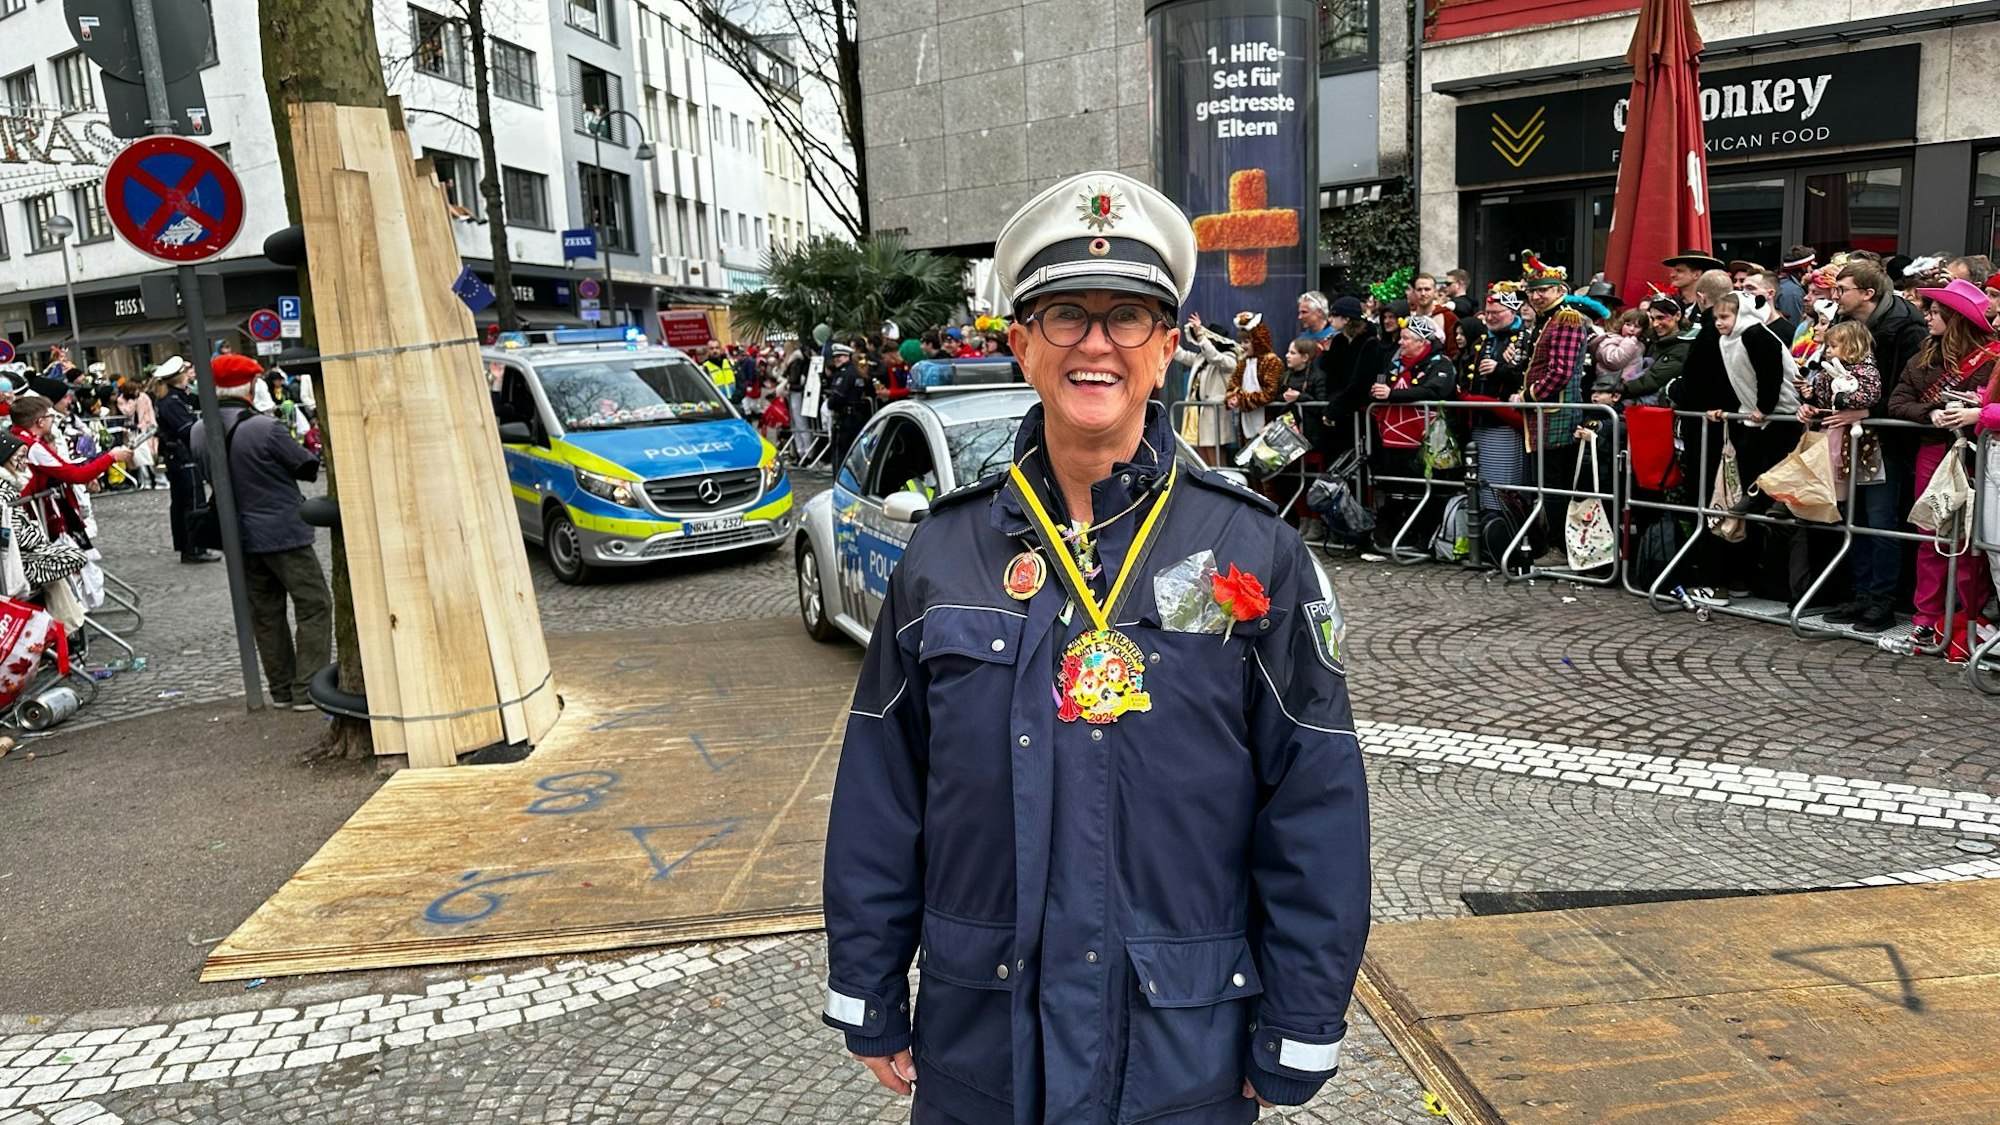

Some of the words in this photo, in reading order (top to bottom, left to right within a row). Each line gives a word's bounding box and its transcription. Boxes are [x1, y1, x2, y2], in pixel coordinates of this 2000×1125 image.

[1207, 46, 1226, 65] 1.
[1231, 42, 1286, 63] Hilfe-
[1213, 69, 1247, 90] Set
[1250, 67, 1281, 87] für
[1196, 93, 1295, 121] gestresste
[1217, 118, 1278, 138] Eltern
[1771, 126, 1830, 145] FOOD
[564, 235, 592, 247] ZEISS
[115, 298, 138, 316] ZEISS
[282, 300, 294, 317] P
[643, 441, 734, 460] POLIZEI
[691, 520, 708, 533] NRW
[722, 514, 743, 528] 2327
[869, 550, 898, 581] POLI
[1090, 631, 1097, 641] E
[1108, 631, 1144, 664] THEATER
[1095, 642, 1102, 652] E
[1088, 711, 1117, 722] 2024
